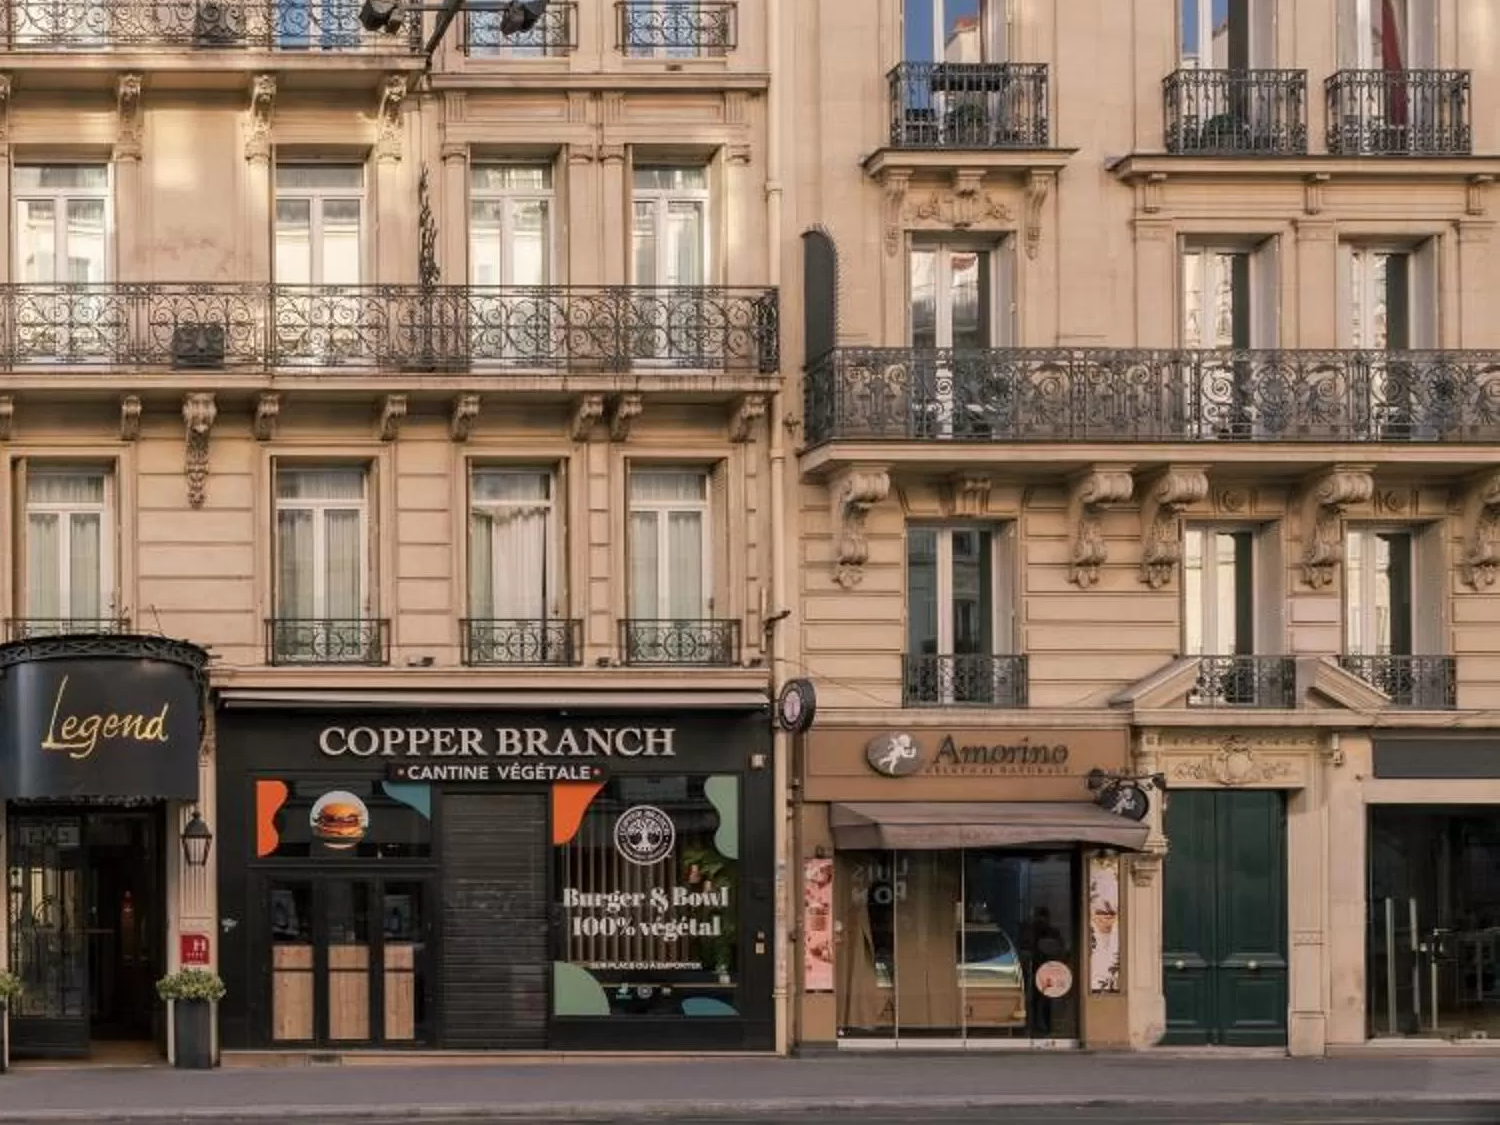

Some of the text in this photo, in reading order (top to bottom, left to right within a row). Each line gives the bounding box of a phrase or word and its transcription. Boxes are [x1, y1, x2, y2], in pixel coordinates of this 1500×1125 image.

[41, 675, 169, 759] Legend
[318, 726, 676, 757] COPPER BRANCH
[932, 733, 1069, 765] Amorino
[407, 762, 591, 780] CANTINE VÉGÉTALE
[563, 886, 729, 914] Burger & Bowl
[573, 915, 721, 942] 100% végétal
[192, 938, 206, 952] H
[607, 961, 635, 970] PLACE
[635, 961, 649, 970] OU
[657, 961, 703, 970] EMPORTER
